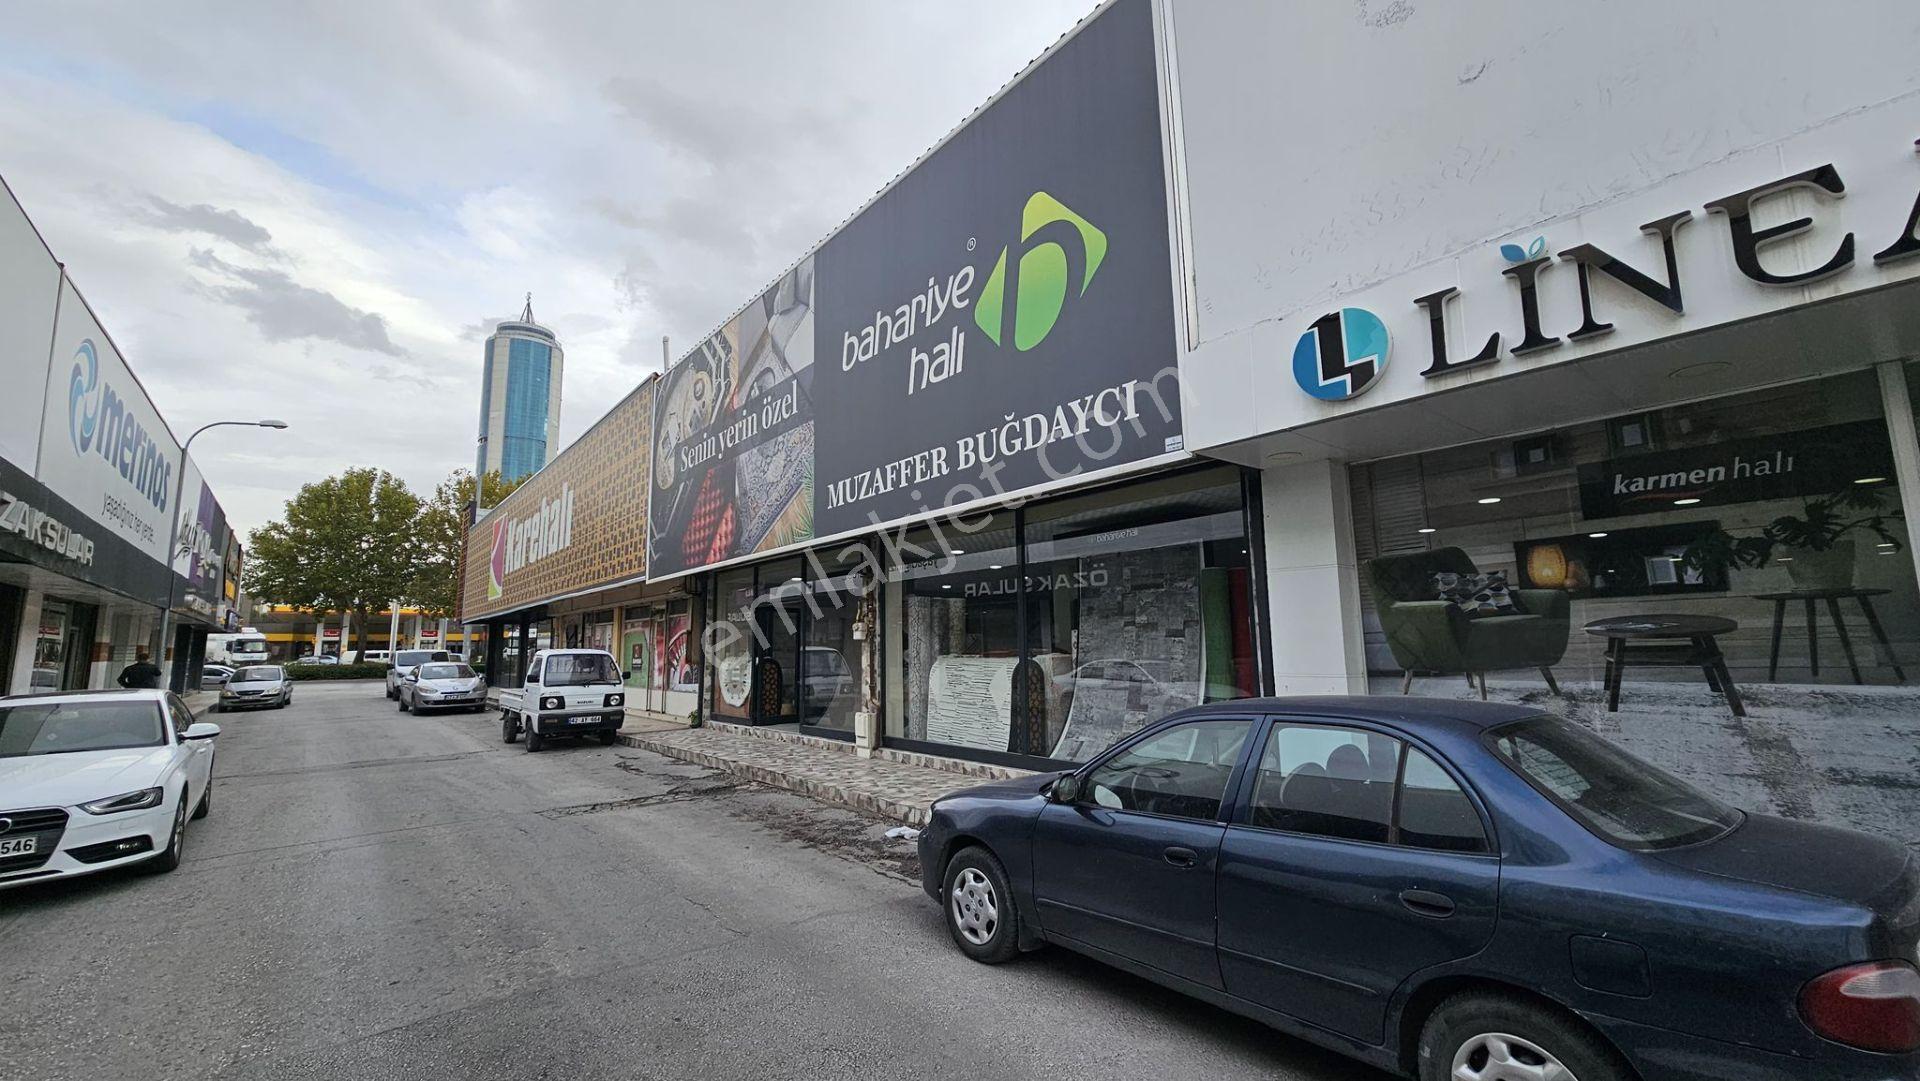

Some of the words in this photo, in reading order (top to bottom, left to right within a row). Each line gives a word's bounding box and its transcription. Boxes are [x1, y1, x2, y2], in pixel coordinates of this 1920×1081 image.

[841, 265, 975, 372] bahariye
[907, 325, 966, 395] halı
[96, 382, 170, 514] merinos
[680, 431, 716, 473] Senin
[718, 409, 758, 459] yerin
[761, 379, 798, 431] özel
[826, 446, 950, 511] MUZAFFER
[957, 380, 1140, 472] BUĞDAYCI
[1612, 466, 1726, 495] karmen
